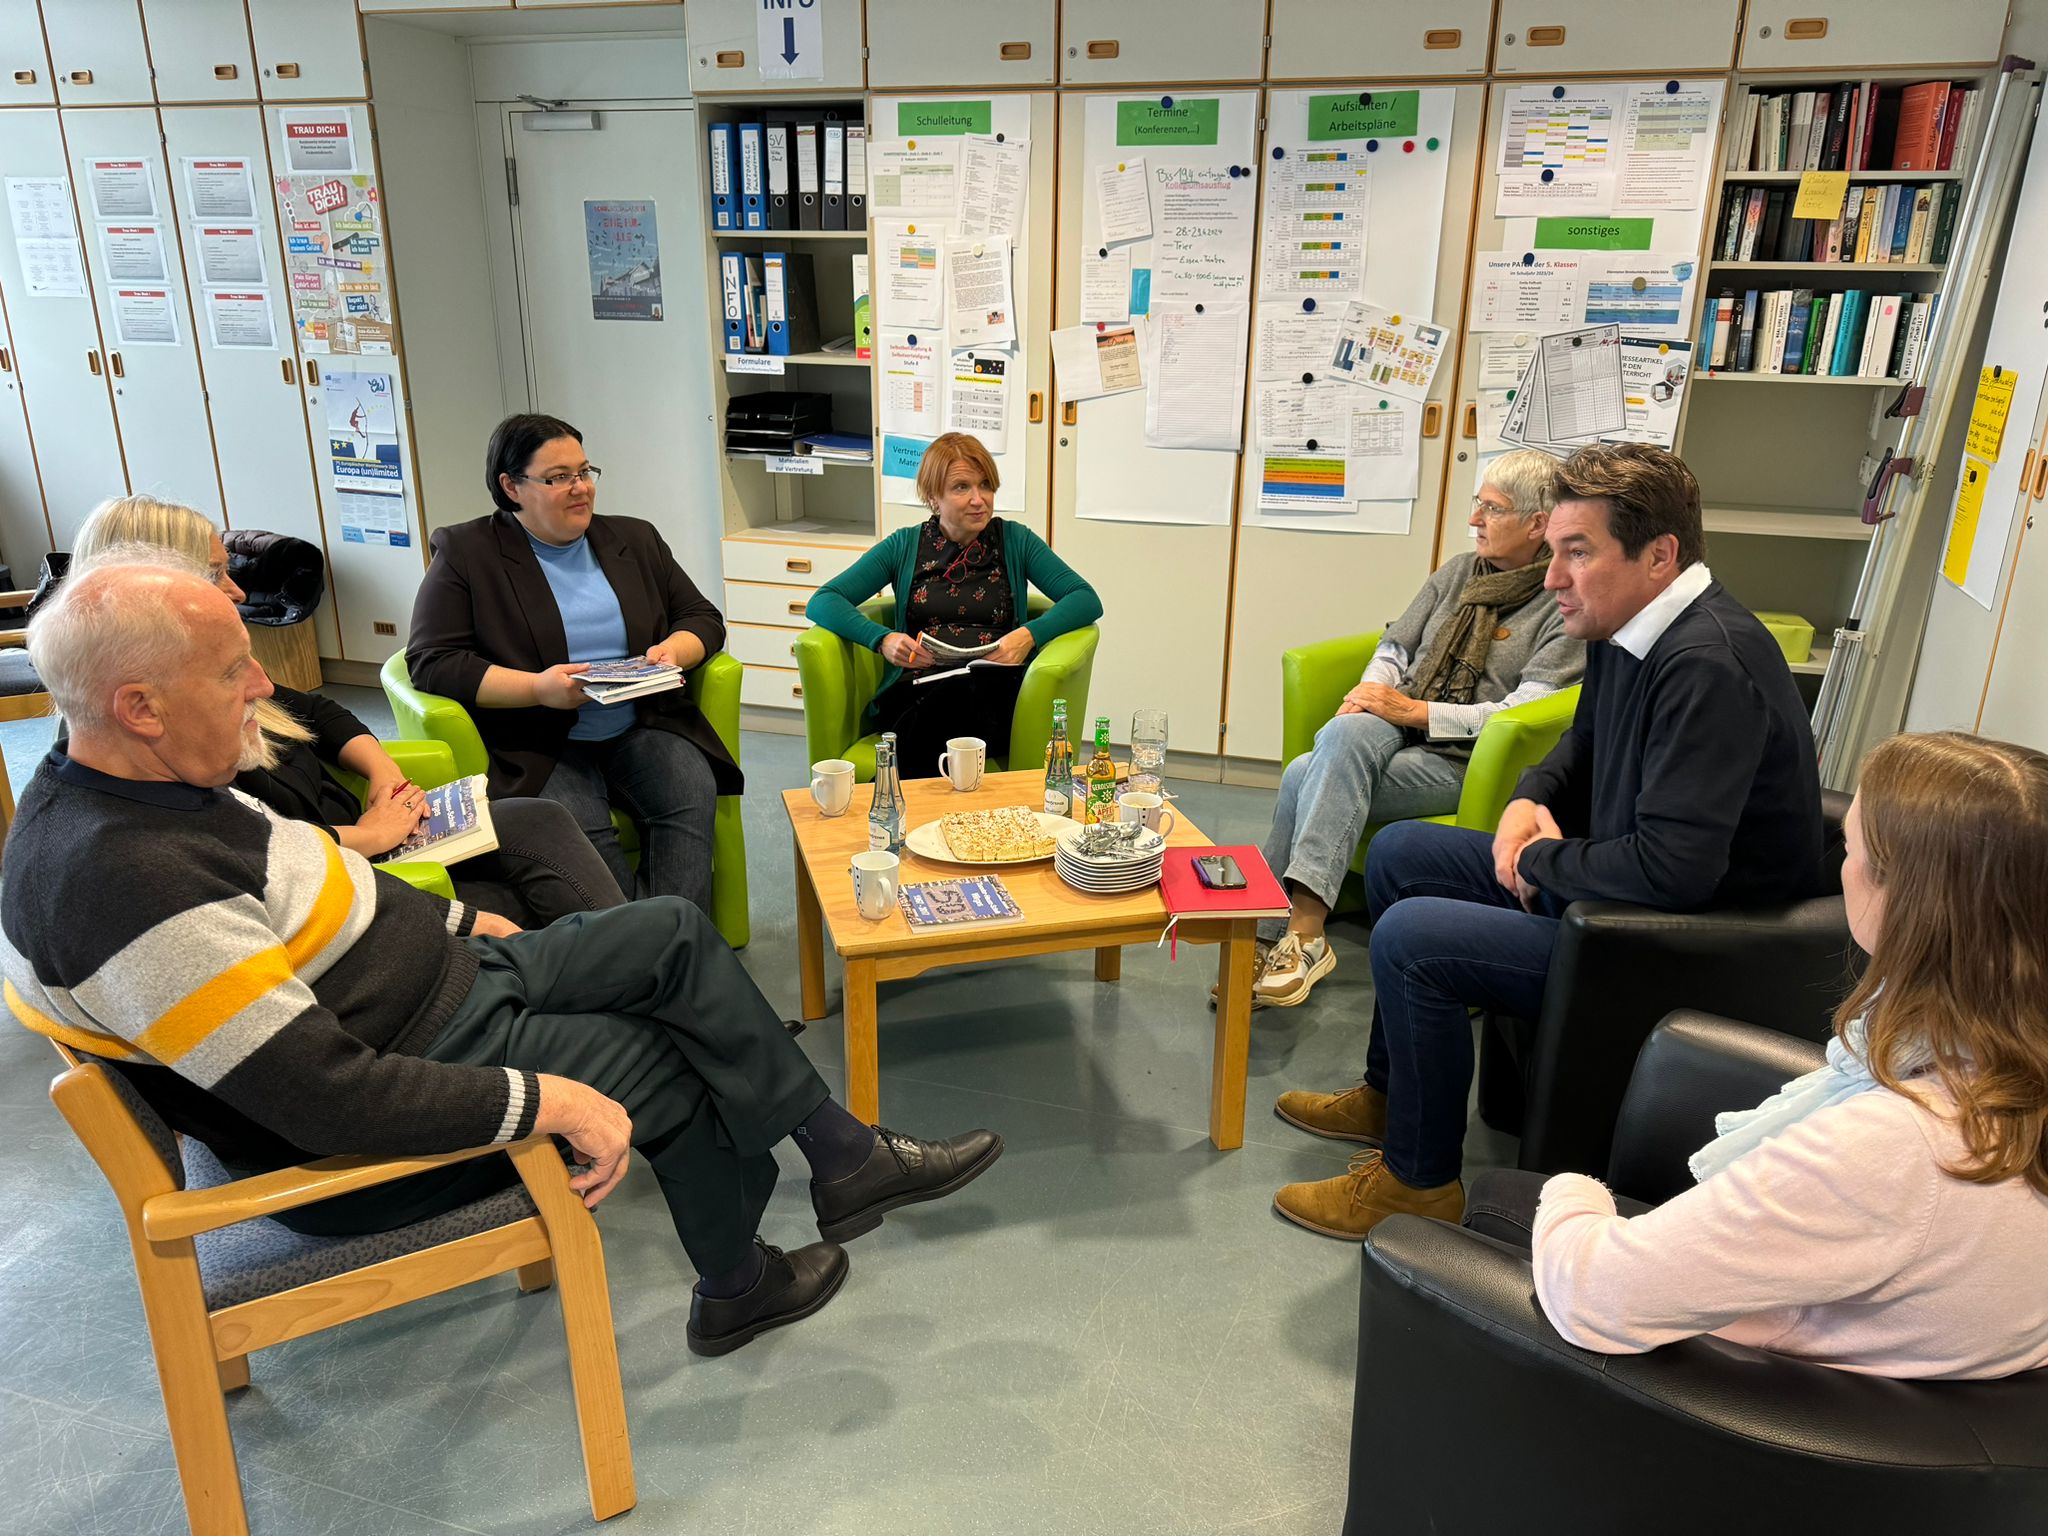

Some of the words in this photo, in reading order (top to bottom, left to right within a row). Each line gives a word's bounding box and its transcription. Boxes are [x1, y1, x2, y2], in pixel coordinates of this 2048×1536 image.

[1390, 97, 1397, 111] /
[1147, 107, 1189, 118] Termine
[916, 115, 973, 127] Schulleitung
[1328, 120, 1397, 132] Arbeitspläne
[293, 126, 315, 134] TRAU
[316, 125, 336, 134] DICH
[1165, 182, 1232, 190] Kollegiumsausflug
[307, 182, 338, 202] TRAU
[1568, 225, 1620, 237] sonstiges
[1174, 240, 1192, 250] Trier
[725, 260, 738, 318] INFO
[738, 357, 771, 366] Formulare
[1622, 356, 1664, 364] ESSEARTIKEL
[892, 446, 924, 457] Vertretu
[899, 458, 920, 468] Mater
[336, 466, 360, 476] Europa
[360, 467, 398, 478] (un)limited
[784, 466, 814, 474] Vertretung
